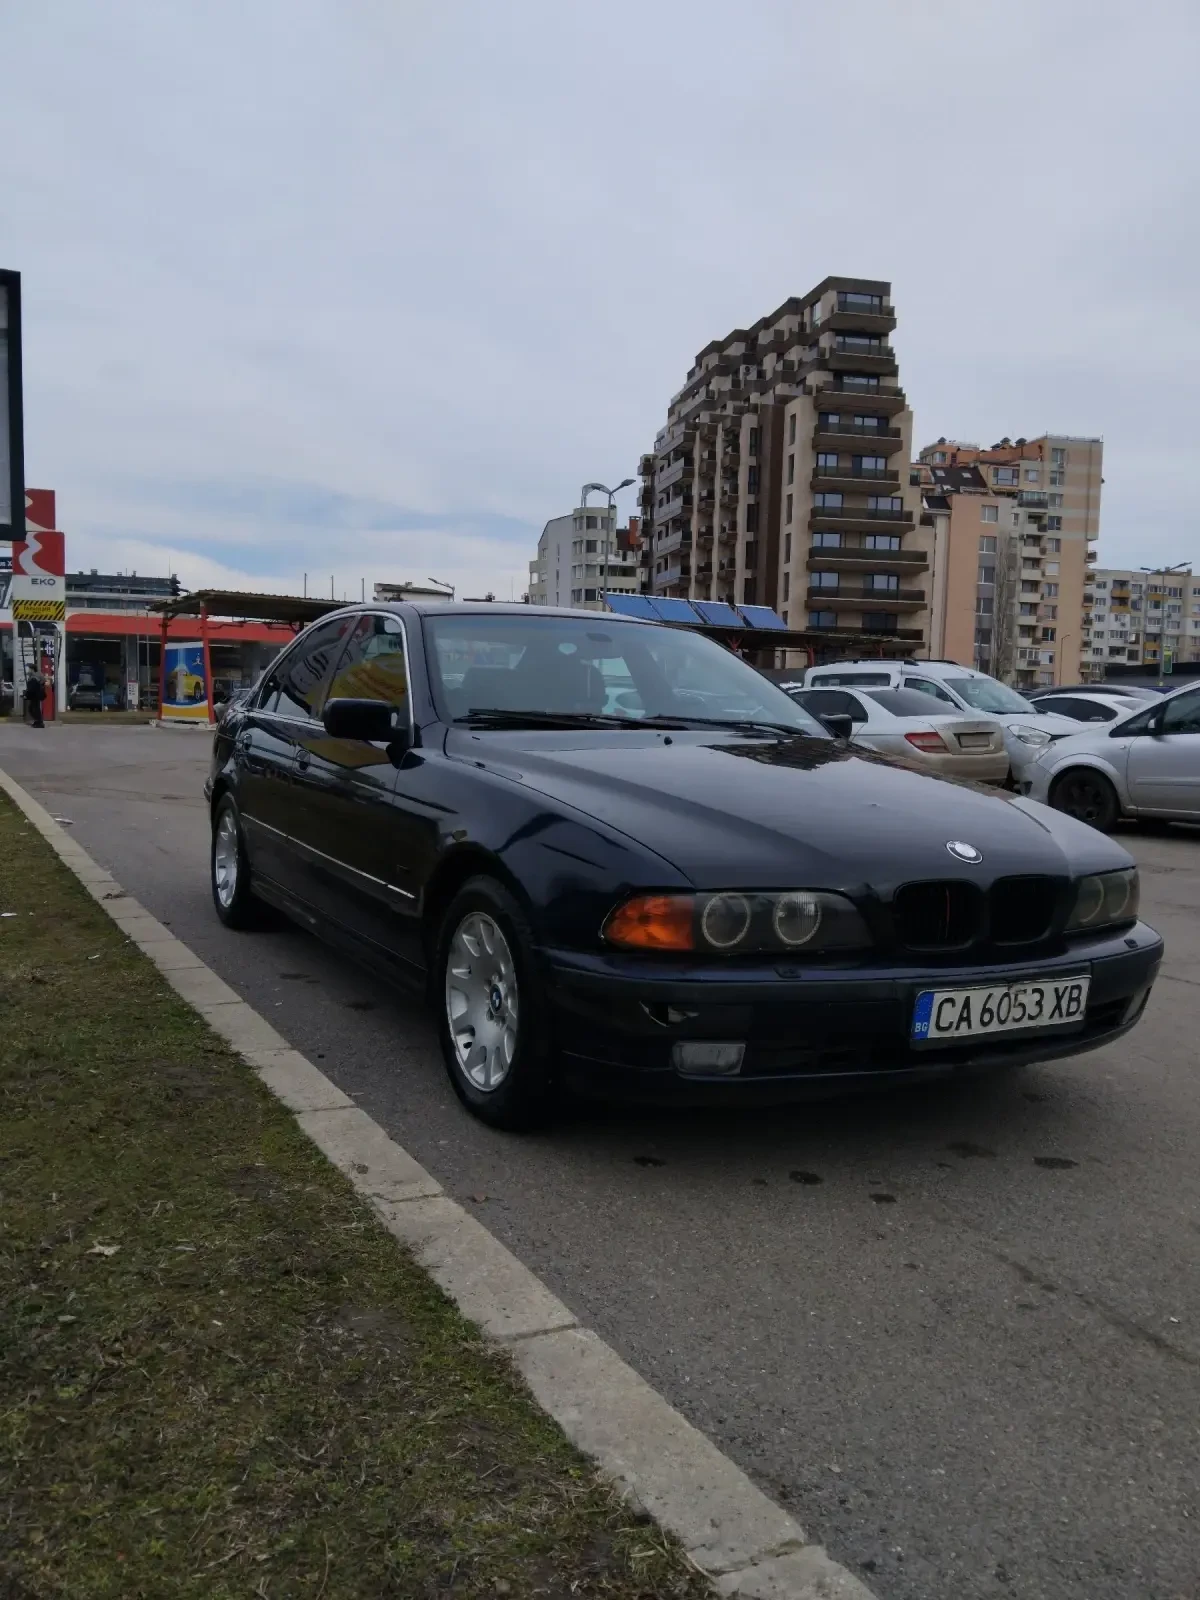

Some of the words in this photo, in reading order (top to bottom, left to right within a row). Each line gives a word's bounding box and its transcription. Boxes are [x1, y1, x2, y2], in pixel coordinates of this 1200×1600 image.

[31, 578, 56, 586] EKO
[935, 996, 973, 1032] CA
[979, 988, 1045, 1027] 6053
[1050, 984, 1083, 1019] XB
[914, 1022, 929, 1033] BG
